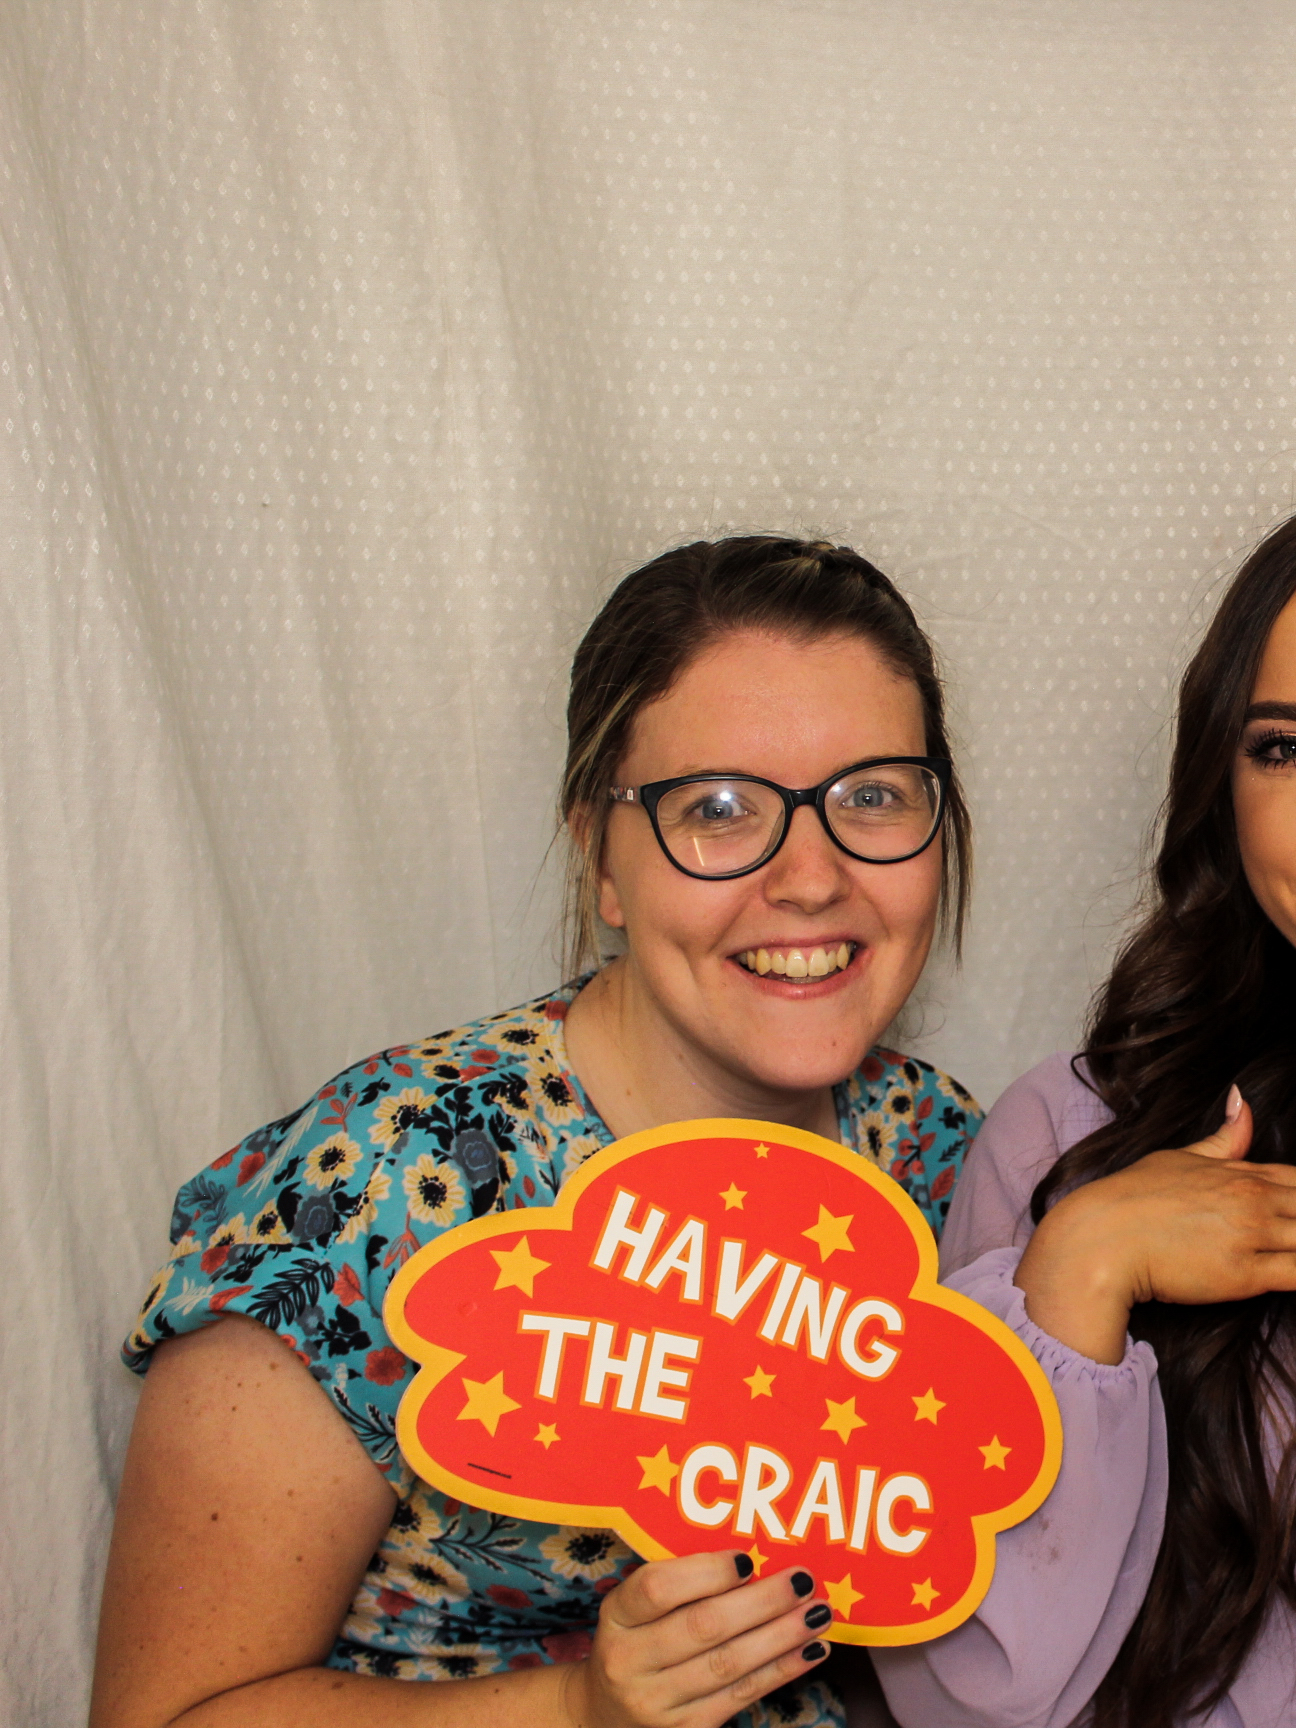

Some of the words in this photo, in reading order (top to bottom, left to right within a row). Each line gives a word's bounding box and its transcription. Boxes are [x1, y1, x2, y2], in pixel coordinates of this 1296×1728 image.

[591, 1188, 904, 1380] HAVING
[520, 1313, 701, 1422] THE
[679, 1444, 932, 1555] CRAIC
